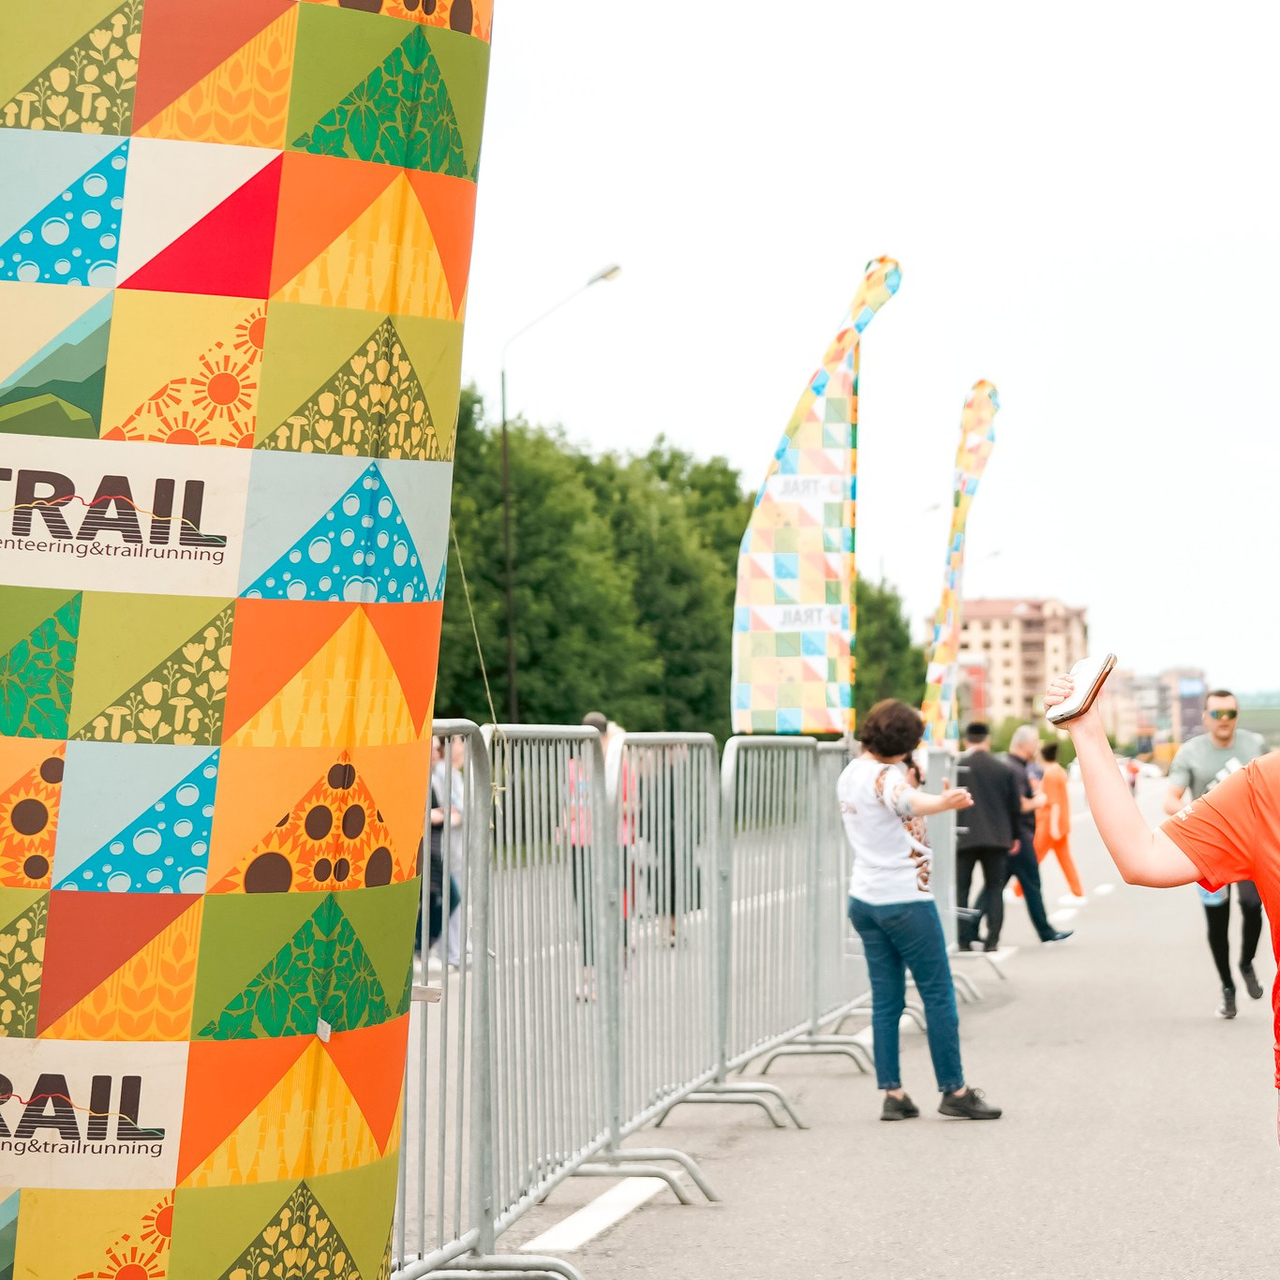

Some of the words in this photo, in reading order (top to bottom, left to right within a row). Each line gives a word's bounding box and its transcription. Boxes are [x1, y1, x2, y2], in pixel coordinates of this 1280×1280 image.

[0, 468, 227, 547] RAIL
[0, 537, 225, 565] nteering&trailrunning
[0, 1073, 165, 1140] AIL
